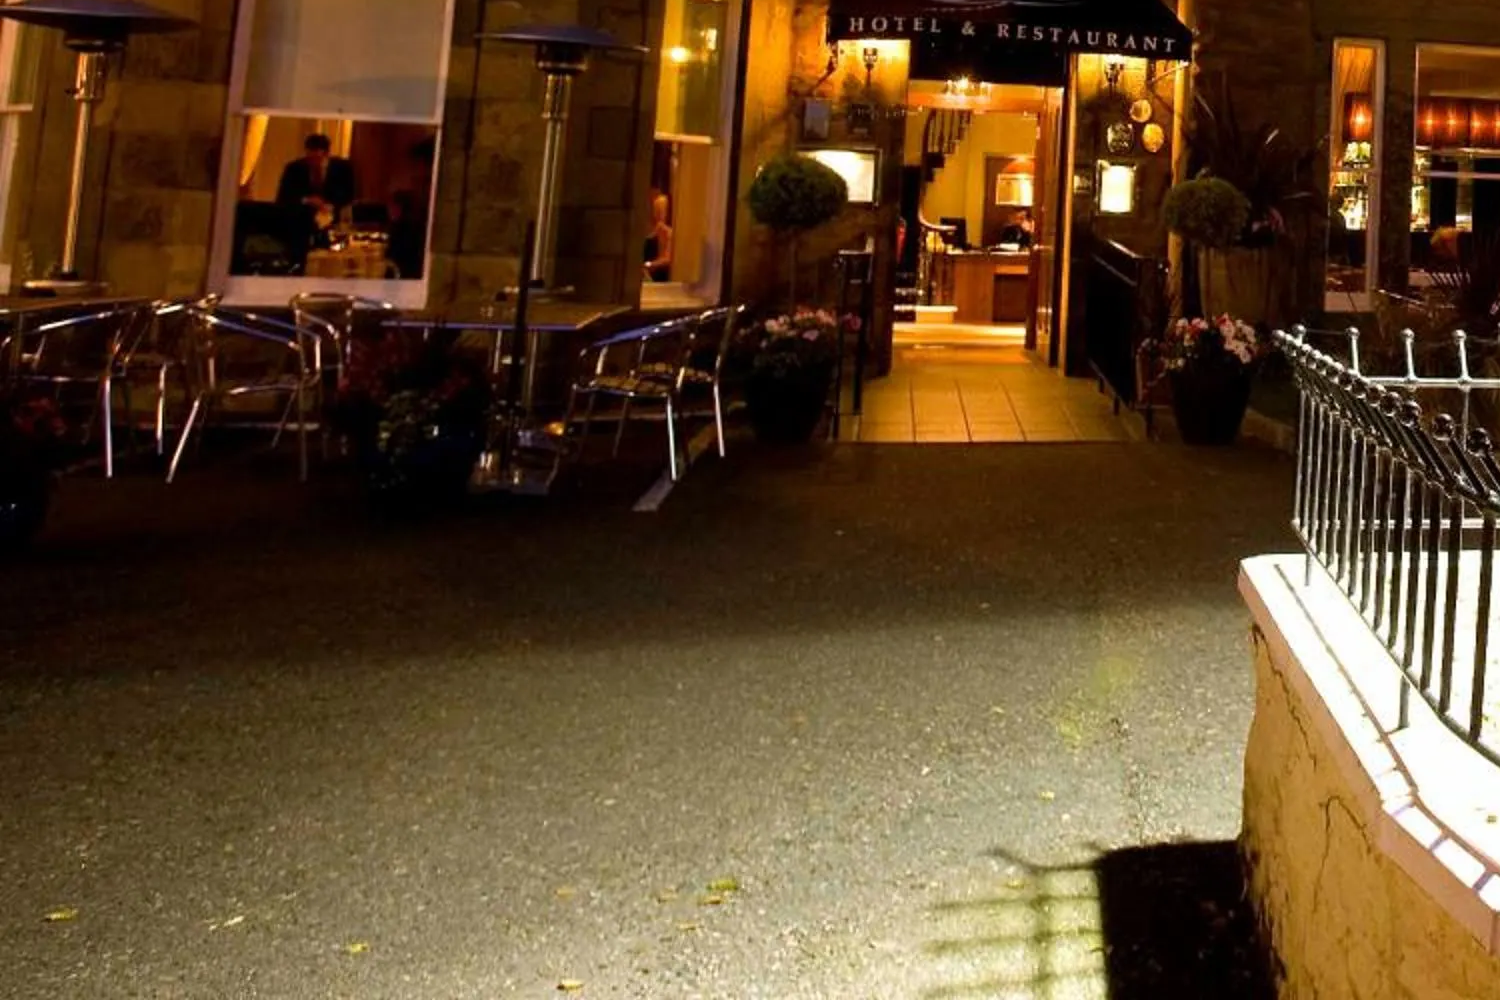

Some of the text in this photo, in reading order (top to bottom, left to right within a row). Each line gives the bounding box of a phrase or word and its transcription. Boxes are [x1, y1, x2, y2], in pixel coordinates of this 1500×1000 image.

[849, 15, 1177, 53] HOTEL & RESTAURANT
